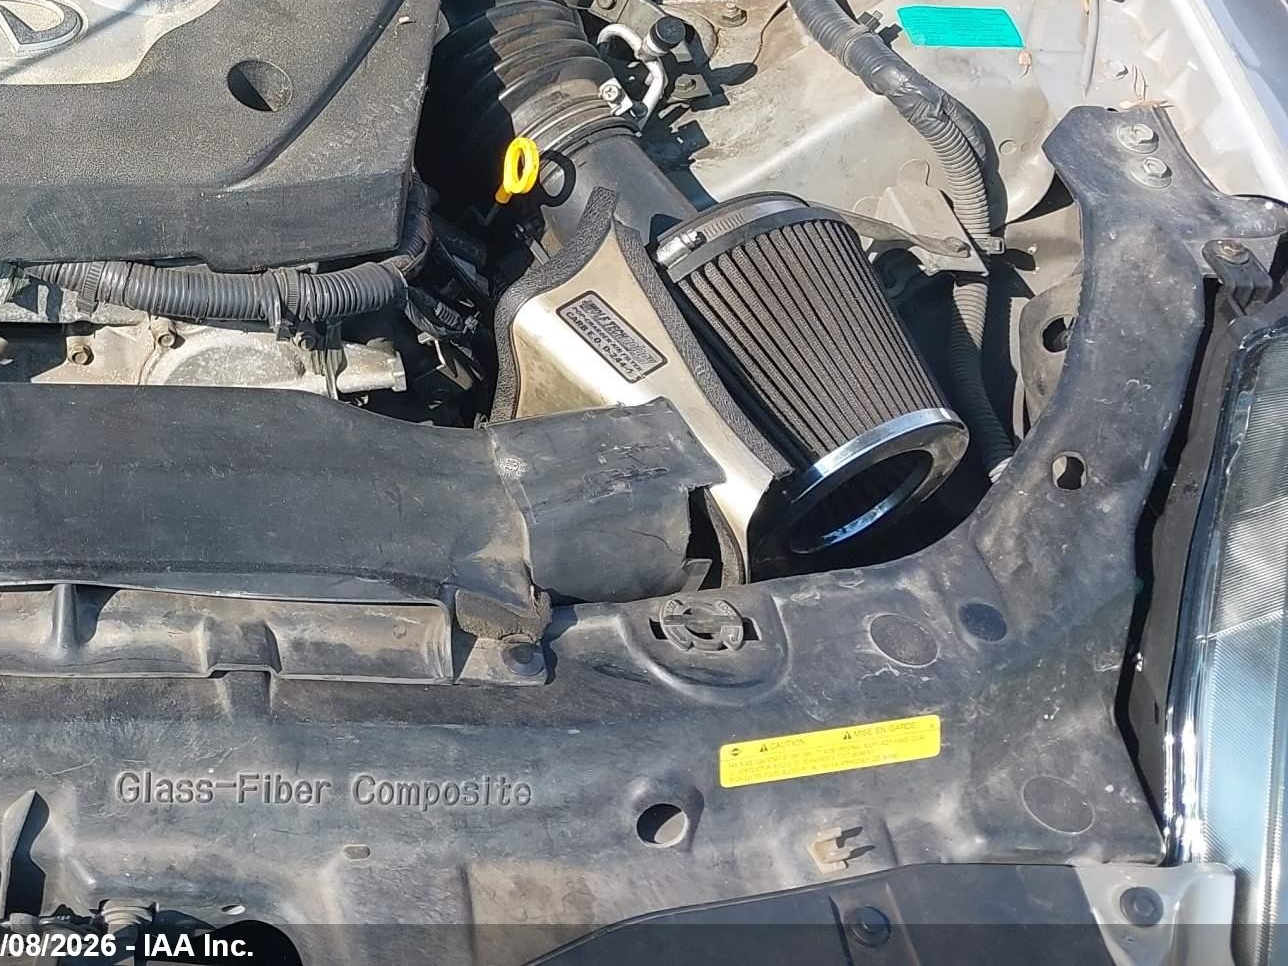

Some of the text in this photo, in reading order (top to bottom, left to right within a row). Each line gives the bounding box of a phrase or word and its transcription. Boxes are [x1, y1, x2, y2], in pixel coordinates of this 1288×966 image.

[566, 311, 588, 332] CARB
[853, 722, 916, 738] MISE EN GARDE
[770, 739, 806, 750] CAUTION
[115, 770, 533, 811] Glass-Fiber Composite
